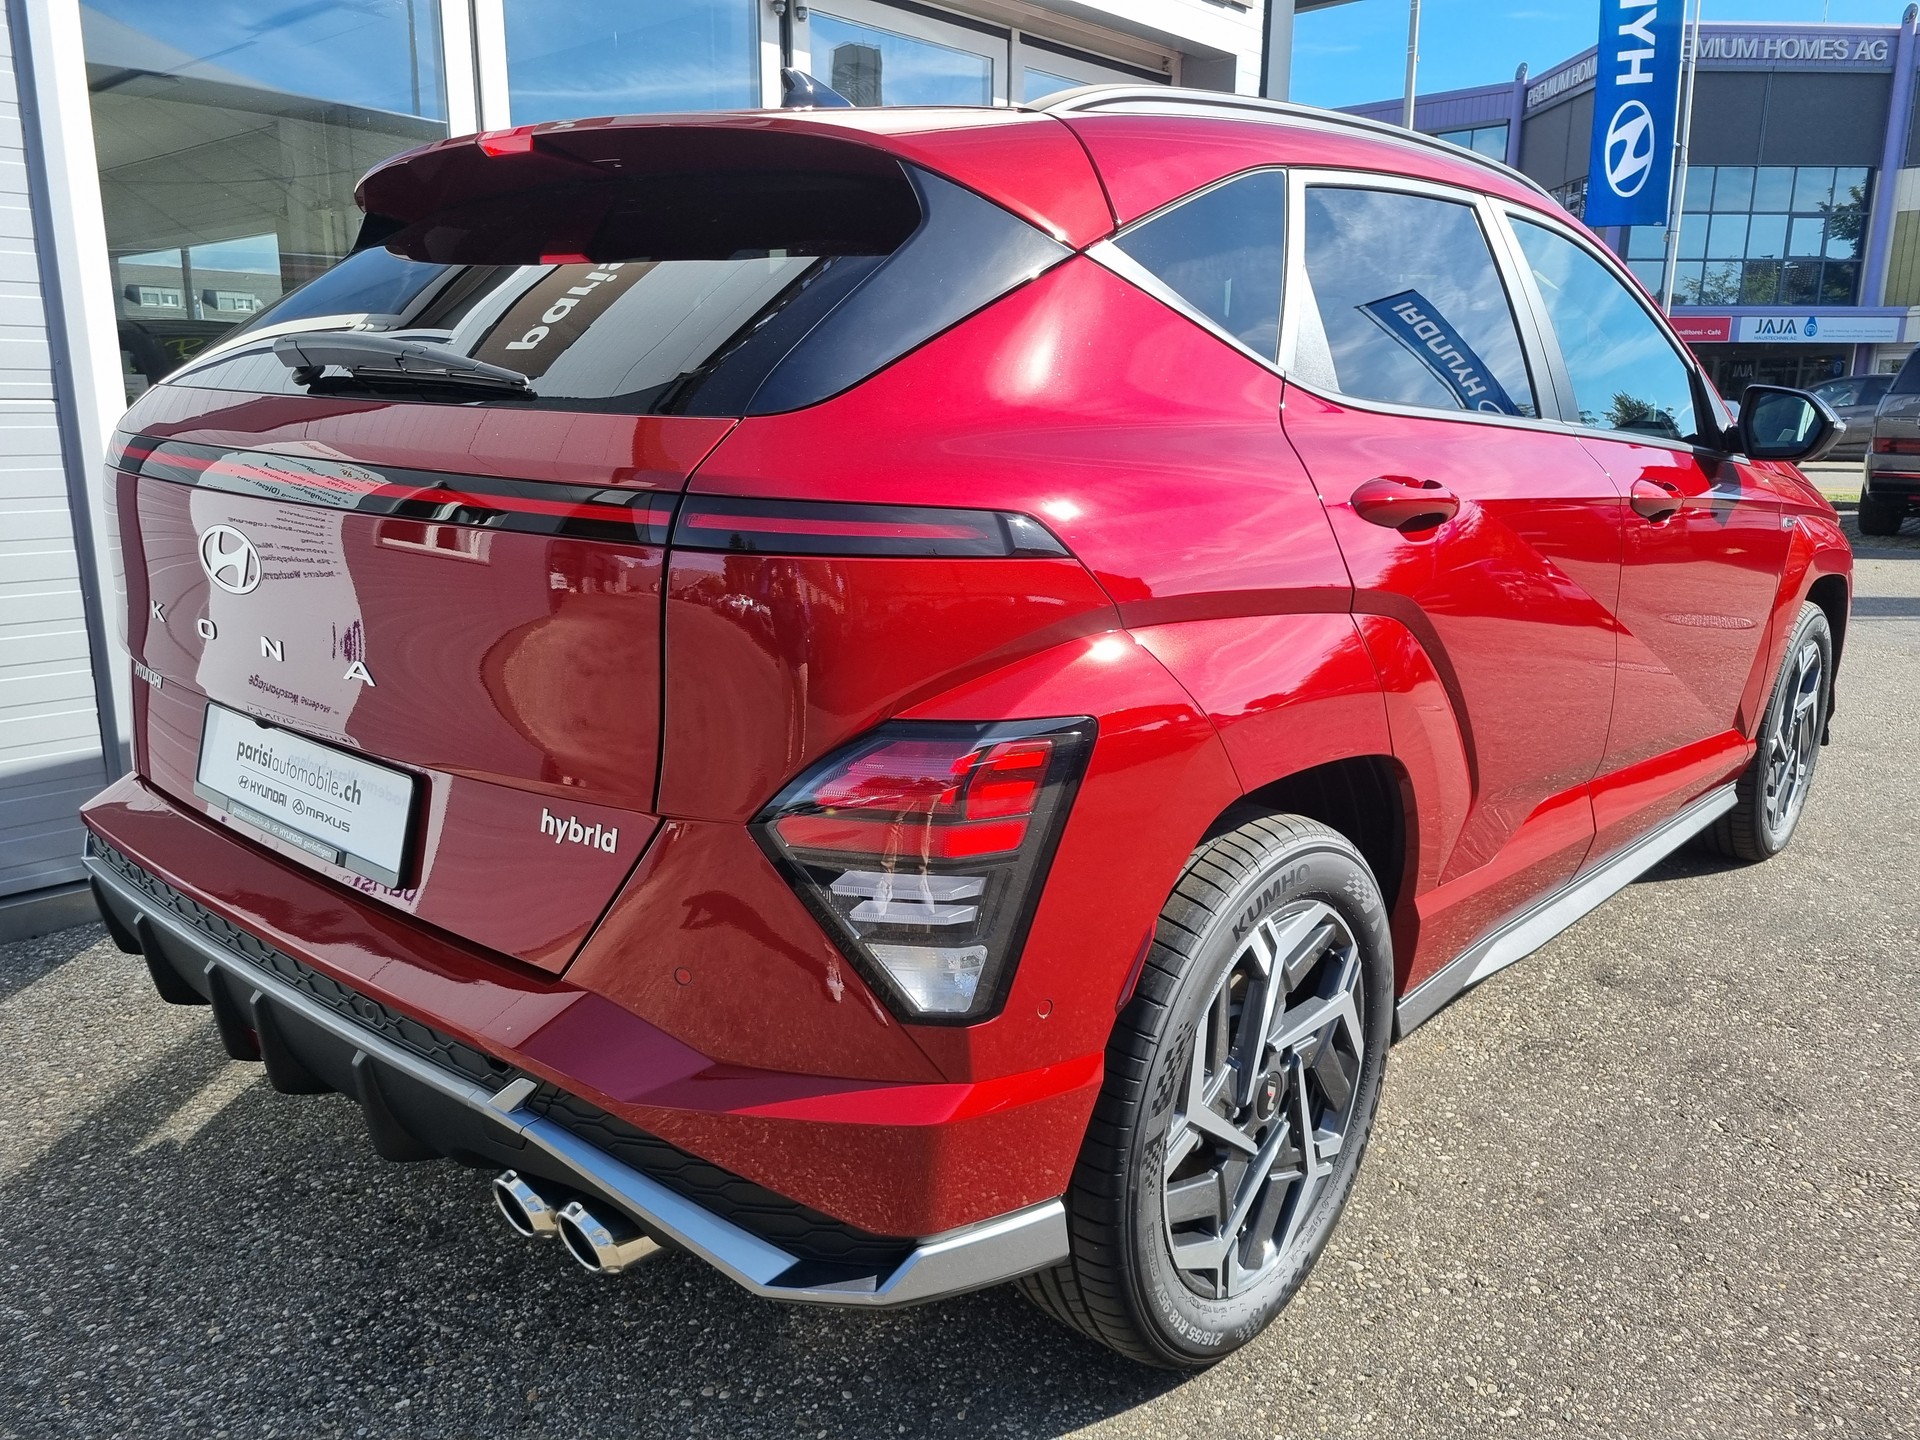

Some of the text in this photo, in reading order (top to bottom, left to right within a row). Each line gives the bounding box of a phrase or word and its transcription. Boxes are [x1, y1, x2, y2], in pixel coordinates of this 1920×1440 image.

[1763, 38, 1849, 60] HOMES
[1852, 39, 1889, 61] AG
[1527, 53, 1598, 108] PREMIUM HOM
[1391, 301, 1487, 397] HYUNDAI
[1755, 319, 1797, 334] JAJA
[151, 600, 377, 687] KONA
[236, 740, 362, 806] parisiautomobile.ch
[249, 780, 350, 833] HYUNDAI MAXUS
[540, 807, 619, 853] hybrid
[278, 827, 303, 845] HYUNDAI
[1232, 863, 1311, 943] KUMHO
[1168, 1311, 1190, 1335] R18
[1186, 1328, 1224, 1347] 215/55
